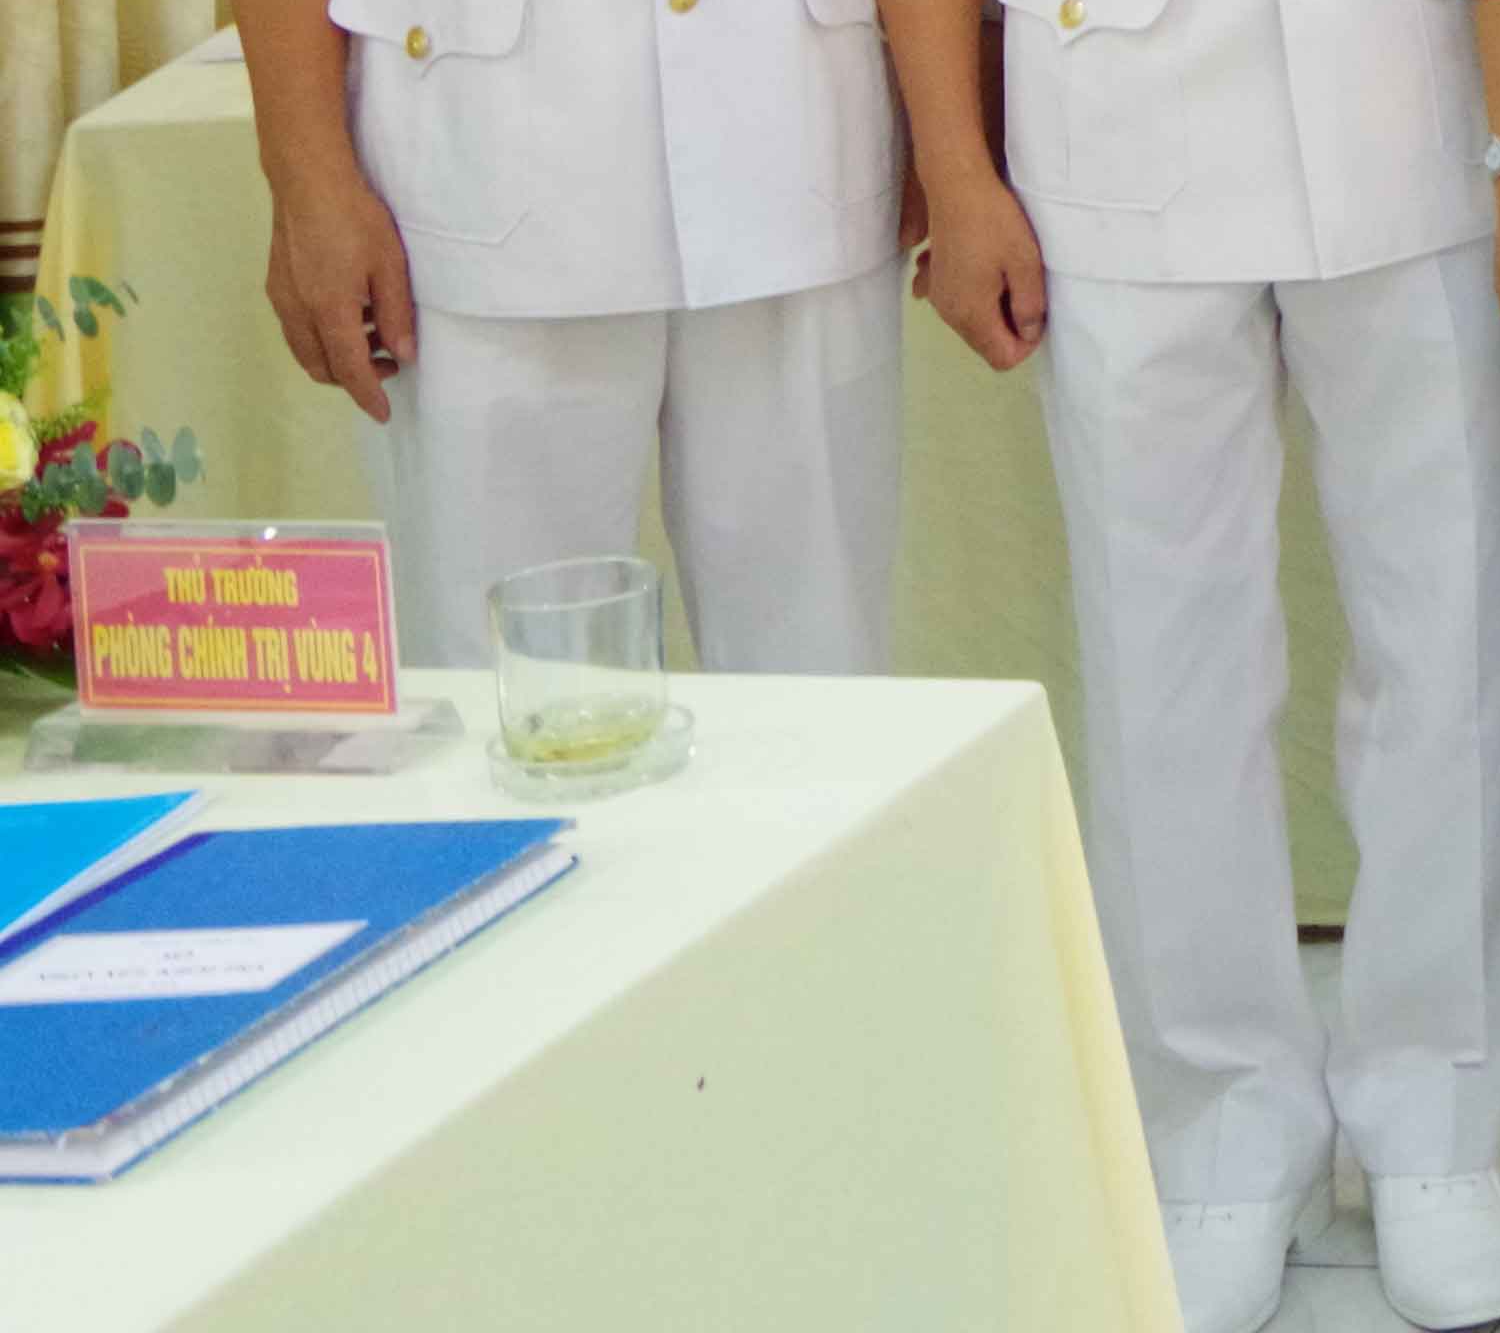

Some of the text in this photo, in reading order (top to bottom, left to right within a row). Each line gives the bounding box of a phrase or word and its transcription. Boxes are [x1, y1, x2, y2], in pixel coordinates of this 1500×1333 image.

[92, 611, 379, 693] PHÒNG CHÍNH TRỊ VÙNG 4
